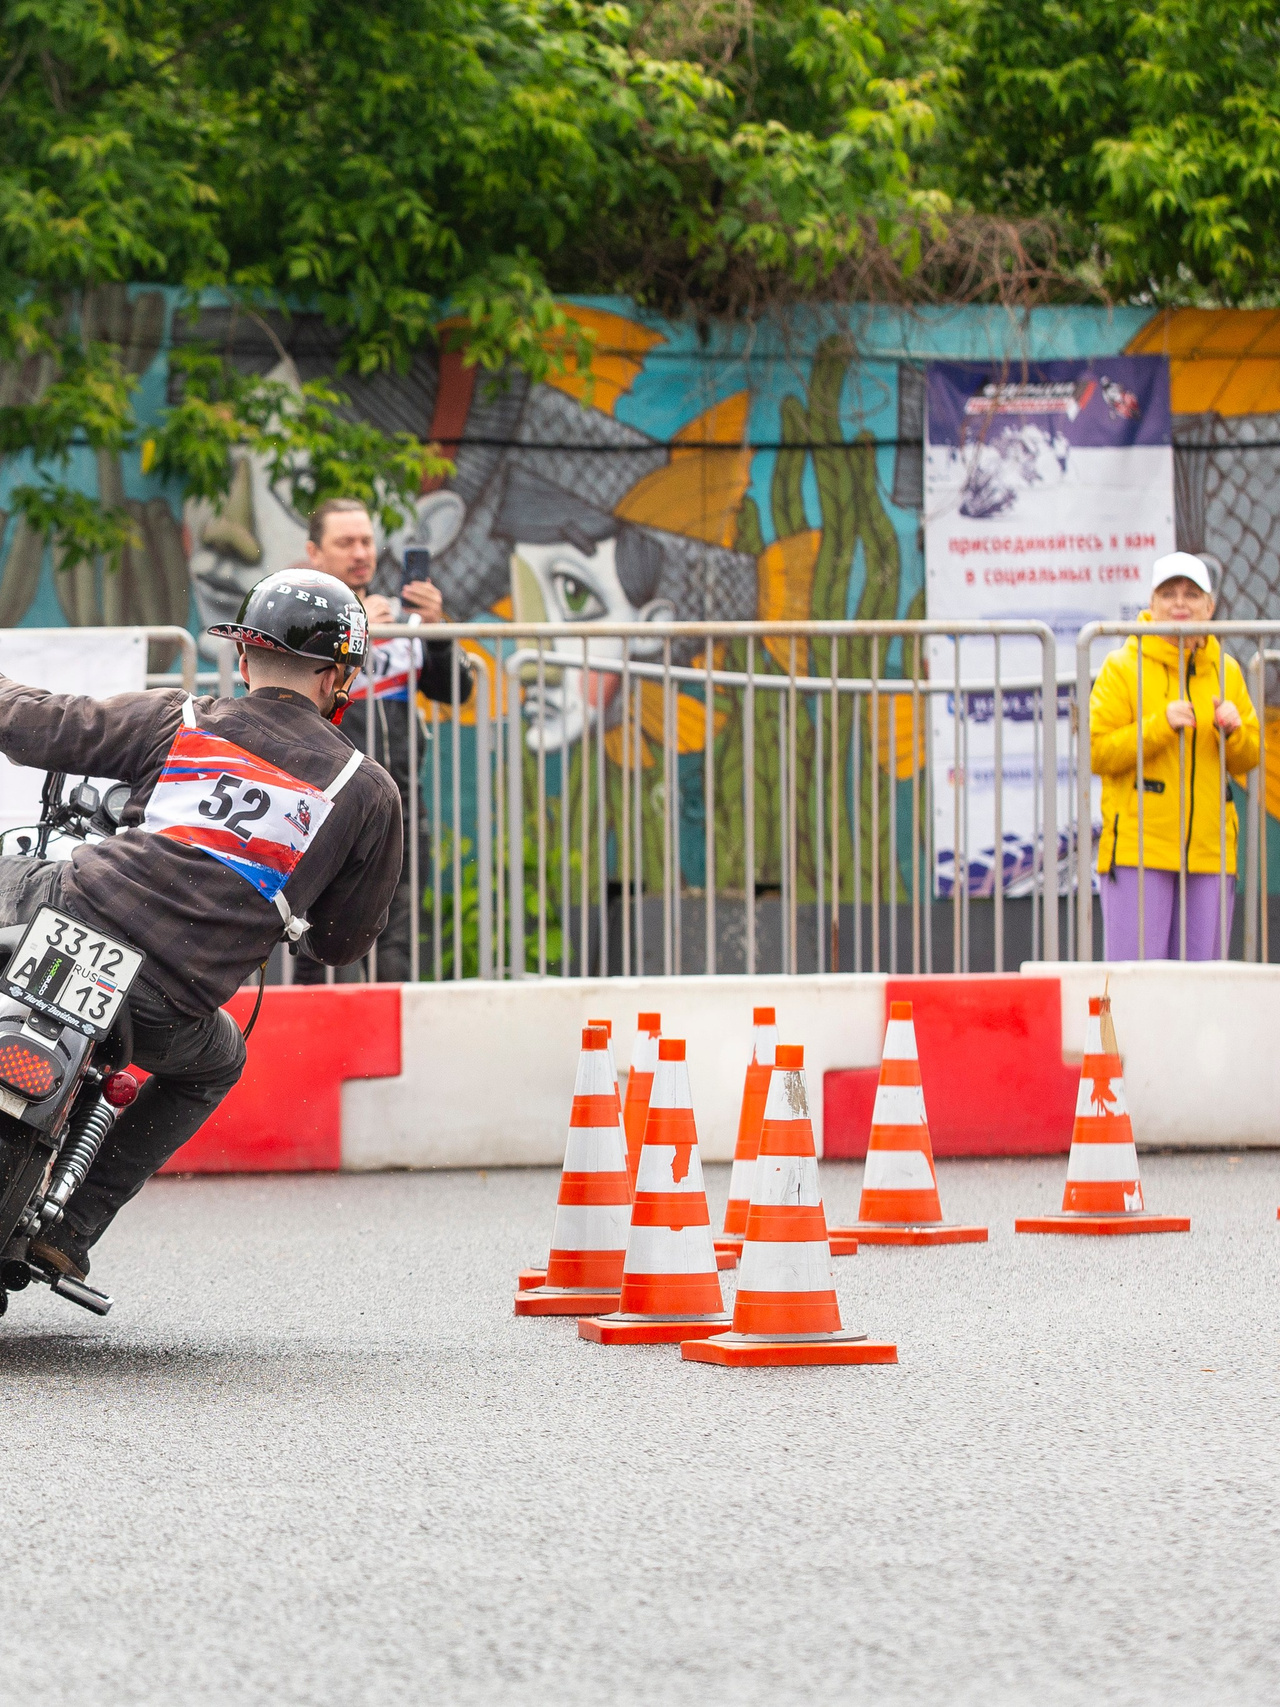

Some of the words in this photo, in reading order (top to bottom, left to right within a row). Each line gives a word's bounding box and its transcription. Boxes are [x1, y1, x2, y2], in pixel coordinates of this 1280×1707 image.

[351, 639, 363, 653] 52
[198, 773, 271, 842] 52
[46, 917, 124, 977] 3312
[73, 963, 98, 983] RUS
[23, 991, 81, 1028] Harley-Davidson
[75, 986, 113, 1020] 13
